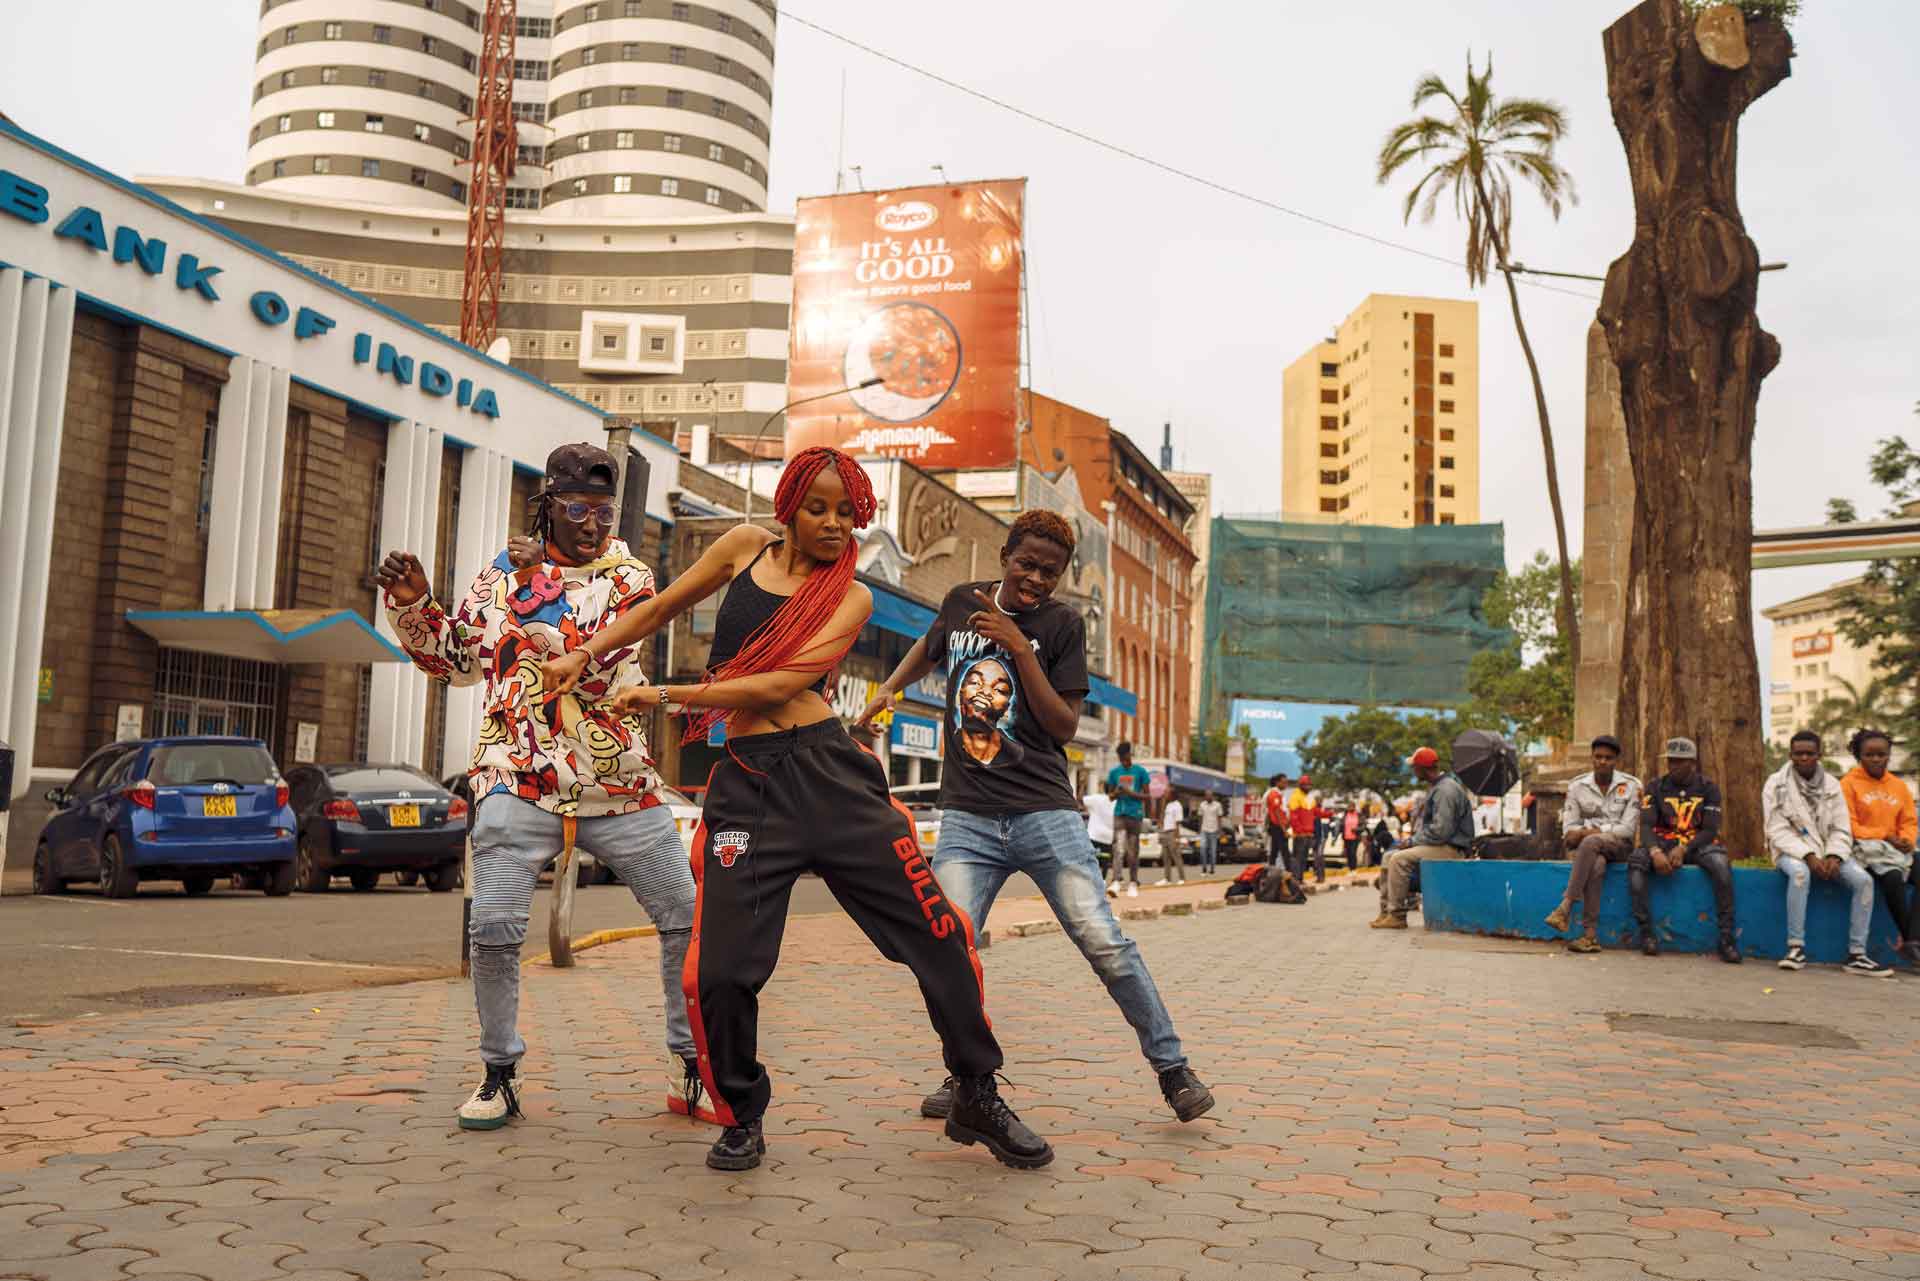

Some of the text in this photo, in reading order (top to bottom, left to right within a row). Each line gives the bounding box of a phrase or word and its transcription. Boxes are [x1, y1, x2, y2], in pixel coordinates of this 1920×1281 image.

[885, 211, 927, 227] Royco
[907, 237, 951, 256] ALL
[855, 254, 955, 283] GOOD
[0, 169, 501, 418] BANK OF INDIA
[911, 281, 942, 297] good
[943, 279, 972, 292] food
[714, 831, 750, 840] CHICAGO
[891, 836, 956, 939] BULLS
